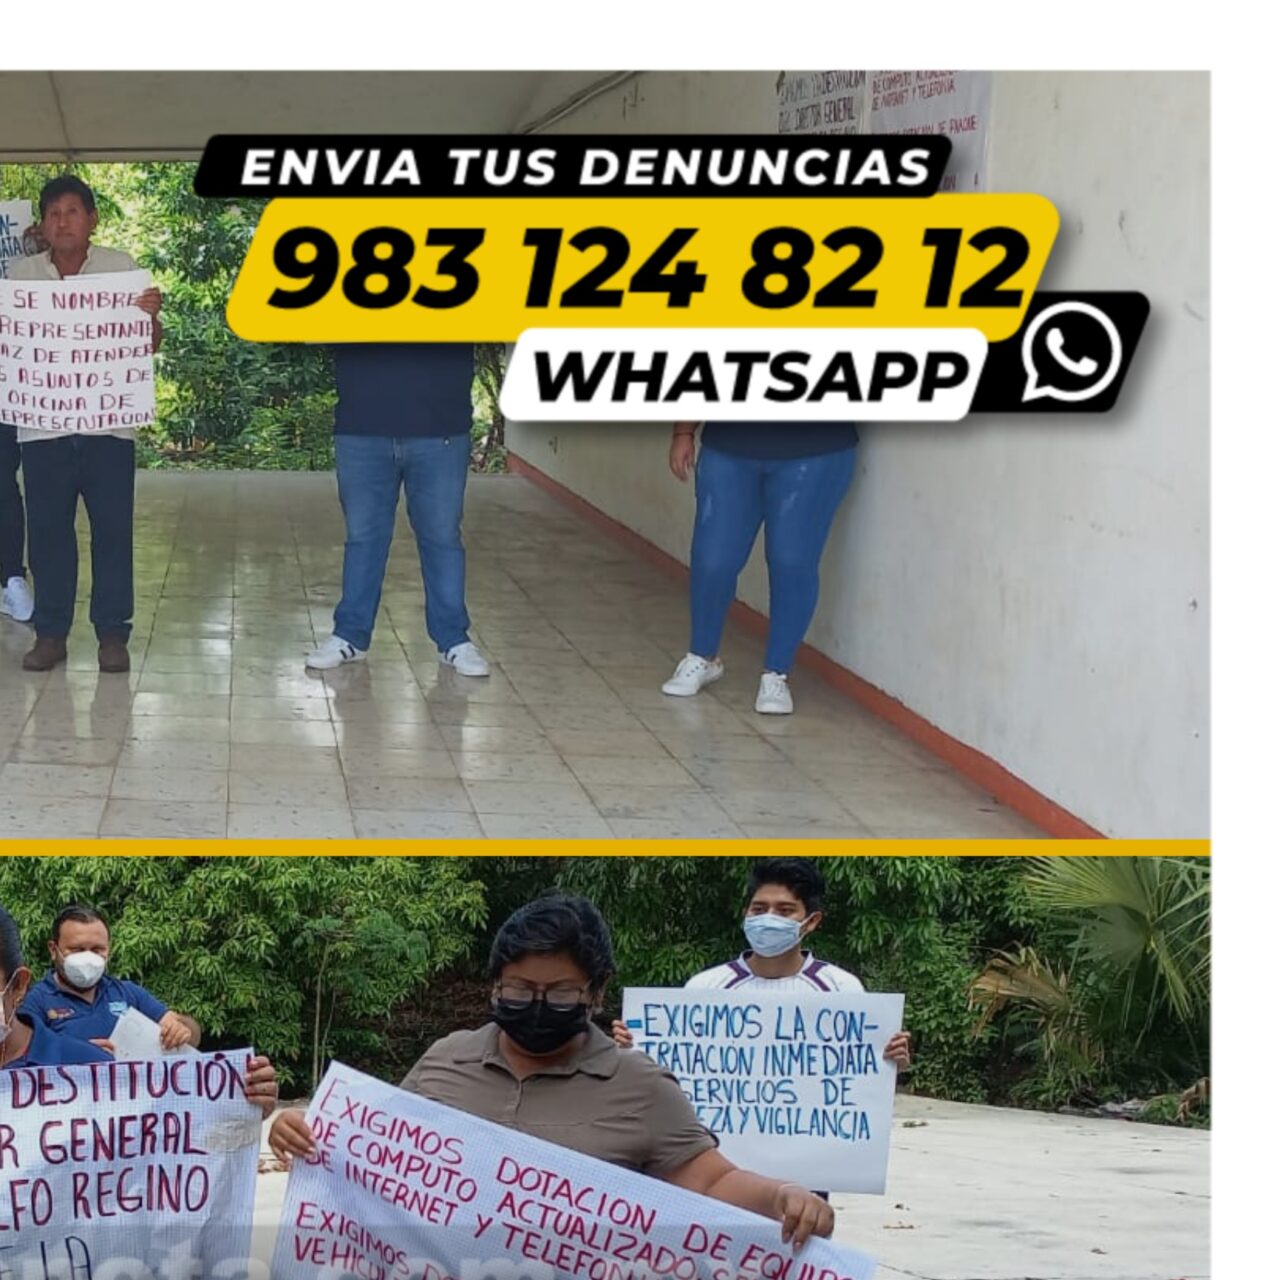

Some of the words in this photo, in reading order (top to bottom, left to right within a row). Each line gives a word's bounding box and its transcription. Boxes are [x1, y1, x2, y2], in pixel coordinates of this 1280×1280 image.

[13, 289, 38, 309] SE
[51, 290, 138, 310] NOMBRE
[34, 346, 60, 364] DE
[19, 367, 114, 389] ASUNTOS
[127, 368, 150, 384] DE
[8, 389, 87, 410] OFICINA
[100, 393, 134, 409] DE
[775, 1006, 804, 1042] LA
[816, 1008, 878, 1042] CON-
[763, 1044, 878, 1076] INMEDIATA
[822, 1078, 857, 1106] DE
[41, 1112, 207, 1164] GENERAL
[753, 1108, 870, 1140] VIGILANCIA
[312, 1116, 339, 1149] DE
[348, 1135, 476, 1202] COMPUTO
[320, 1078, 464, 1164] EXIGIMOS
[497, 1156, 656, 1234] DOTACION
[683, 1224, 732, 1261] DE
[74, 1165, 209, 1219] REGINO
[346, 1161, 457, 1226] INTERNET
[474, 1214, 492, 1238] Y
[296, 1202, 409, 1275] EXIGIMOS
